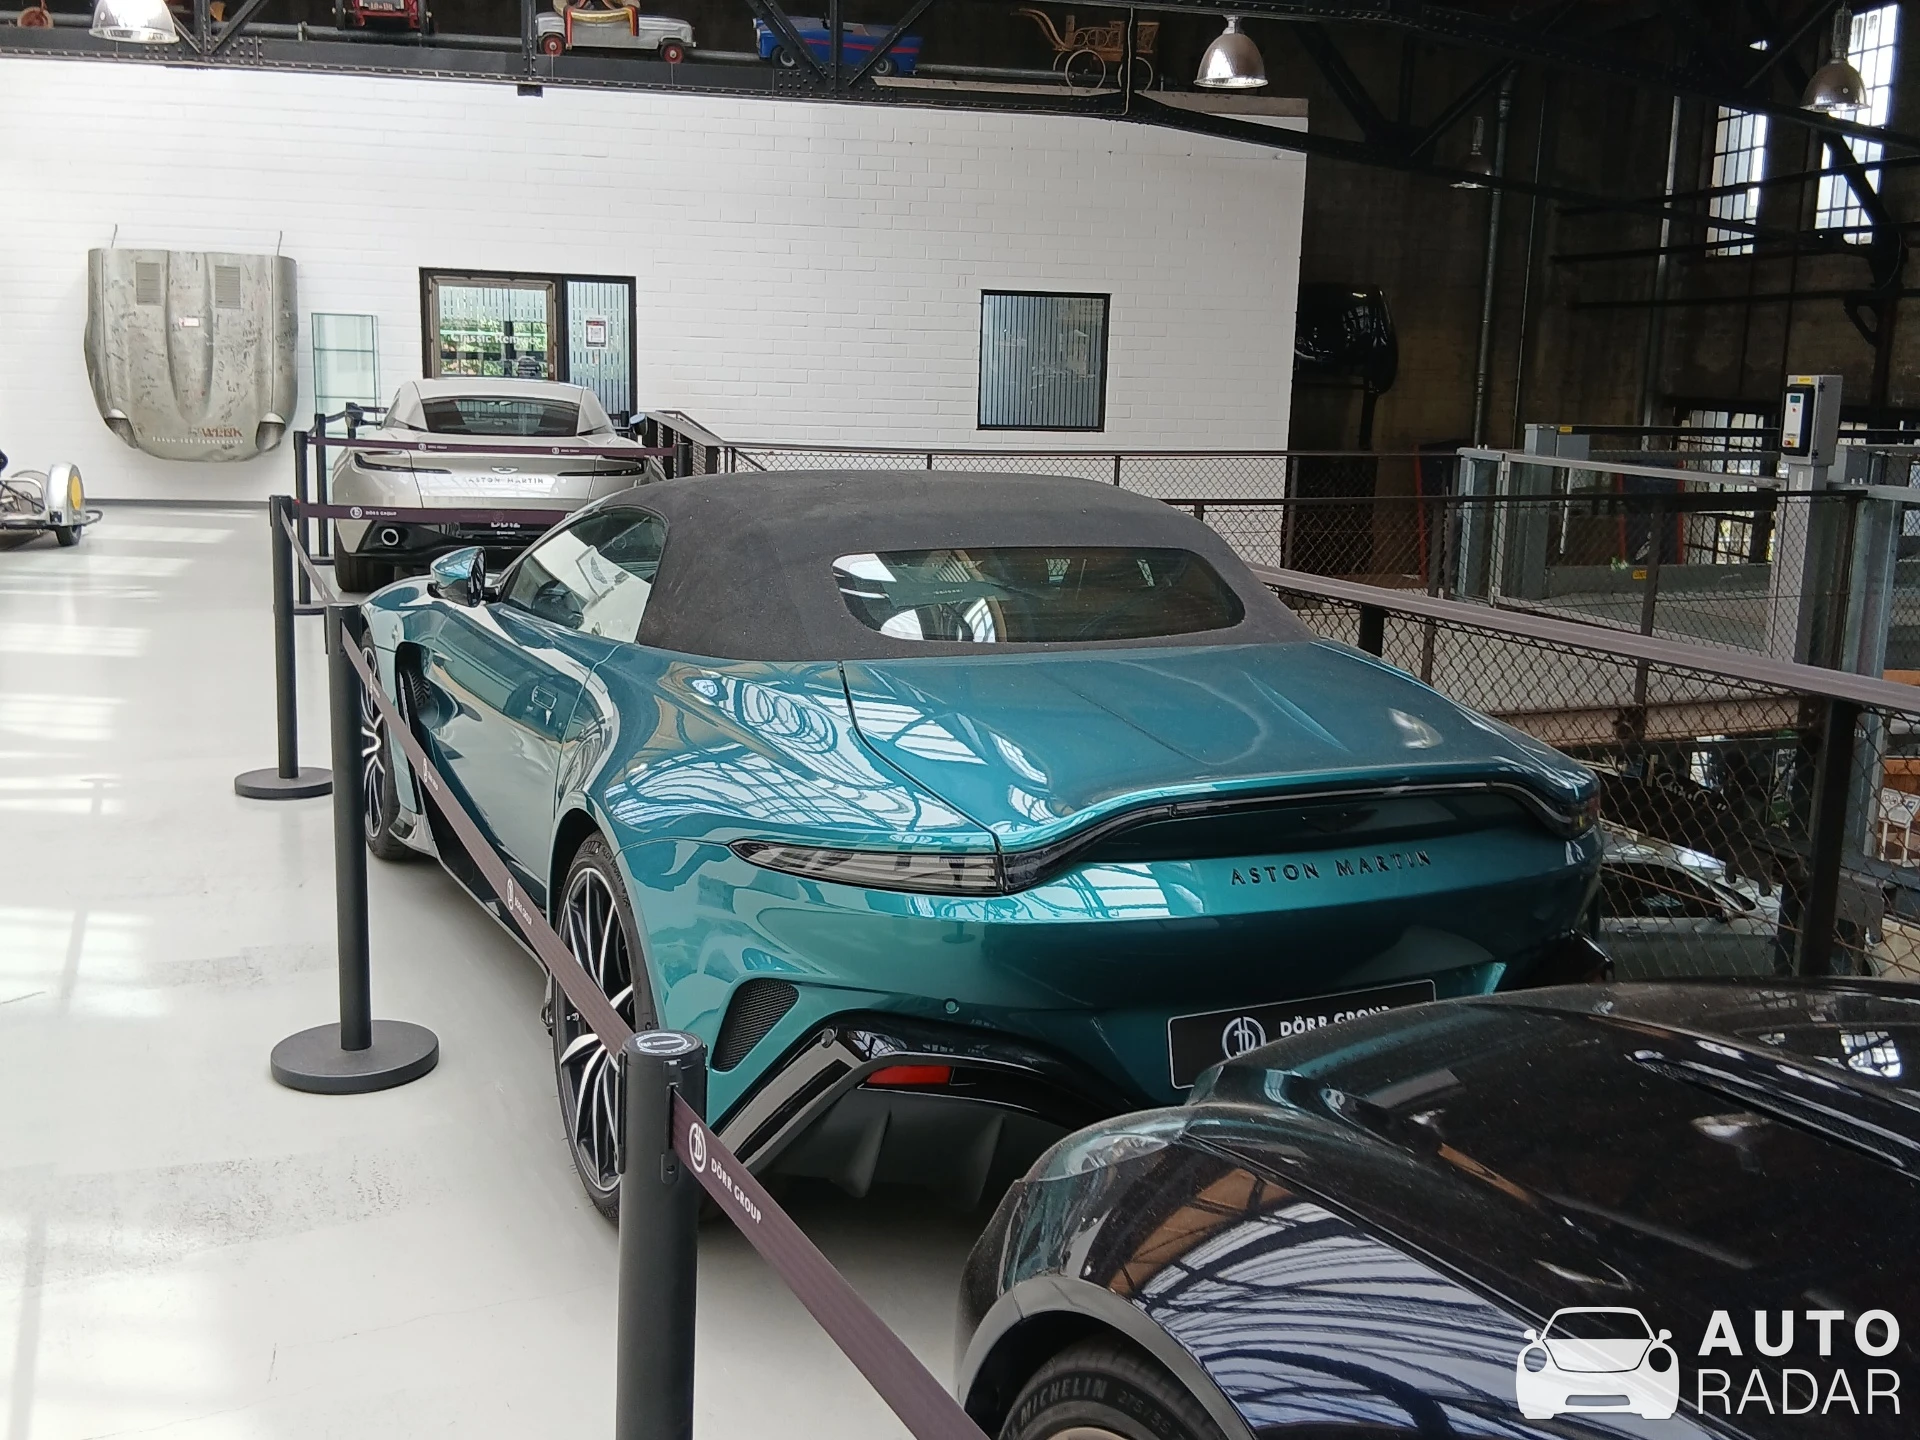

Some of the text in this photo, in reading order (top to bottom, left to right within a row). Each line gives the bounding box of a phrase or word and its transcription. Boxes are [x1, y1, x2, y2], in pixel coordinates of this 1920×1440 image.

[1231, 850, 1431, 885] ASTON MARTIN
[1280, 1016, 1328, 1037] DÖRR
[711, 1157, 762, 1224] DÖRR GROUP
[1021, 1378, 1108, 1425] MICHELIN
